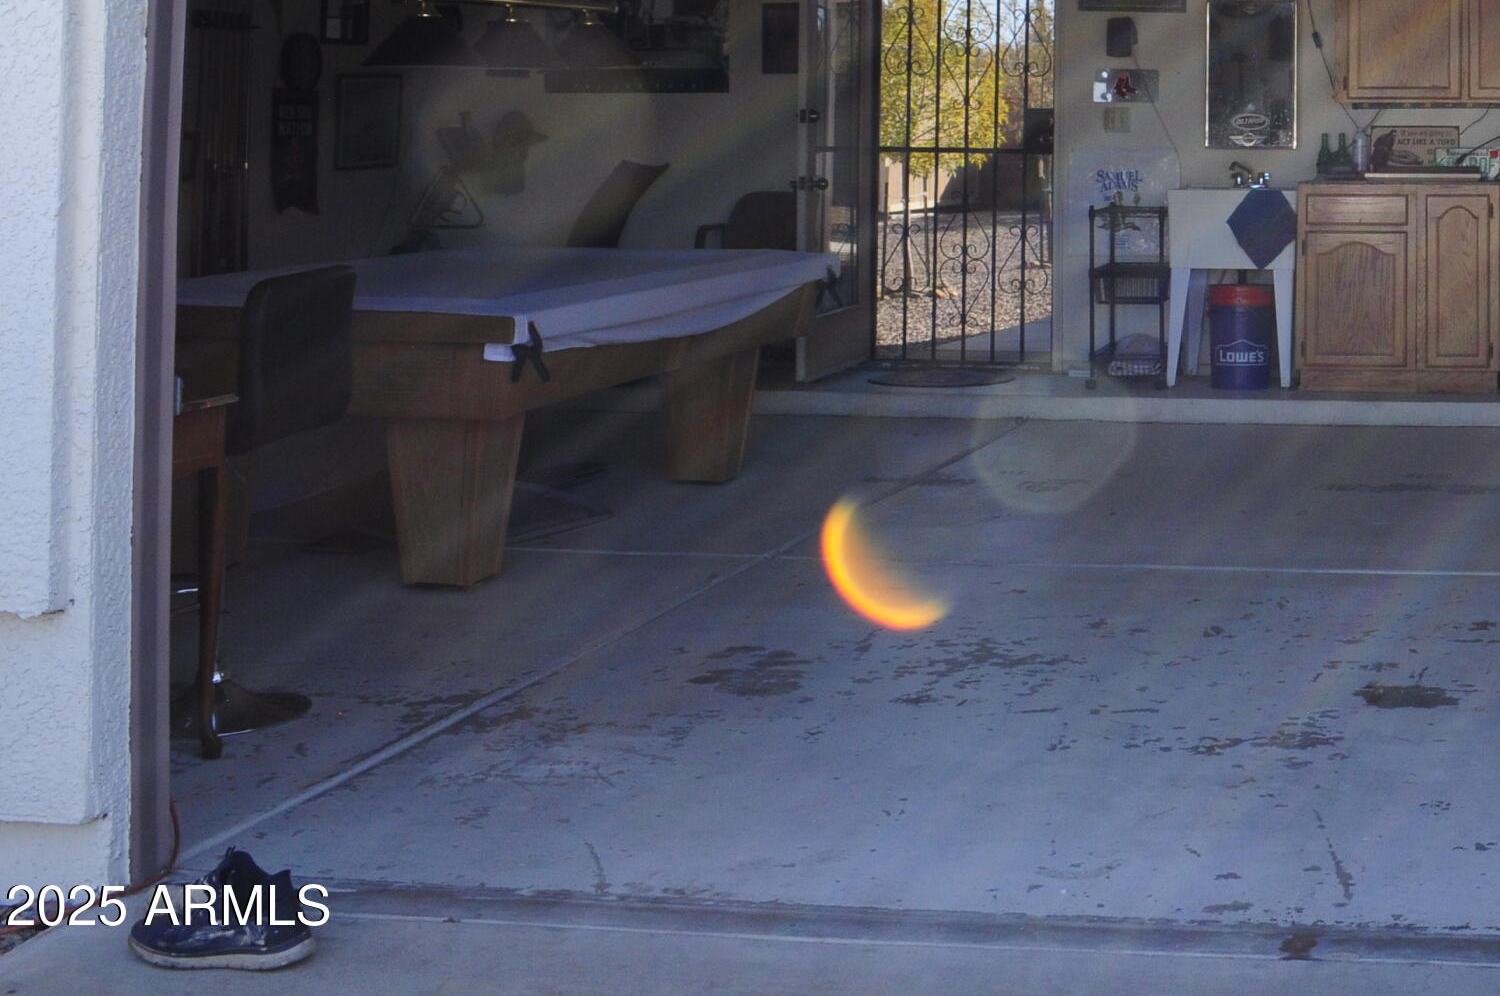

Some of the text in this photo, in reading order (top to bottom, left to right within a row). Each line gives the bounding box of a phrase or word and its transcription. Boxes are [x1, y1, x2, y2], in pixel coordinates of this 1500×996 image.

[1096, 169, 1143, 183] SAMUEL
[1099, 180, 1138, 192] ADAMS
[1220, 349, 1265, 363] LOWE'S
